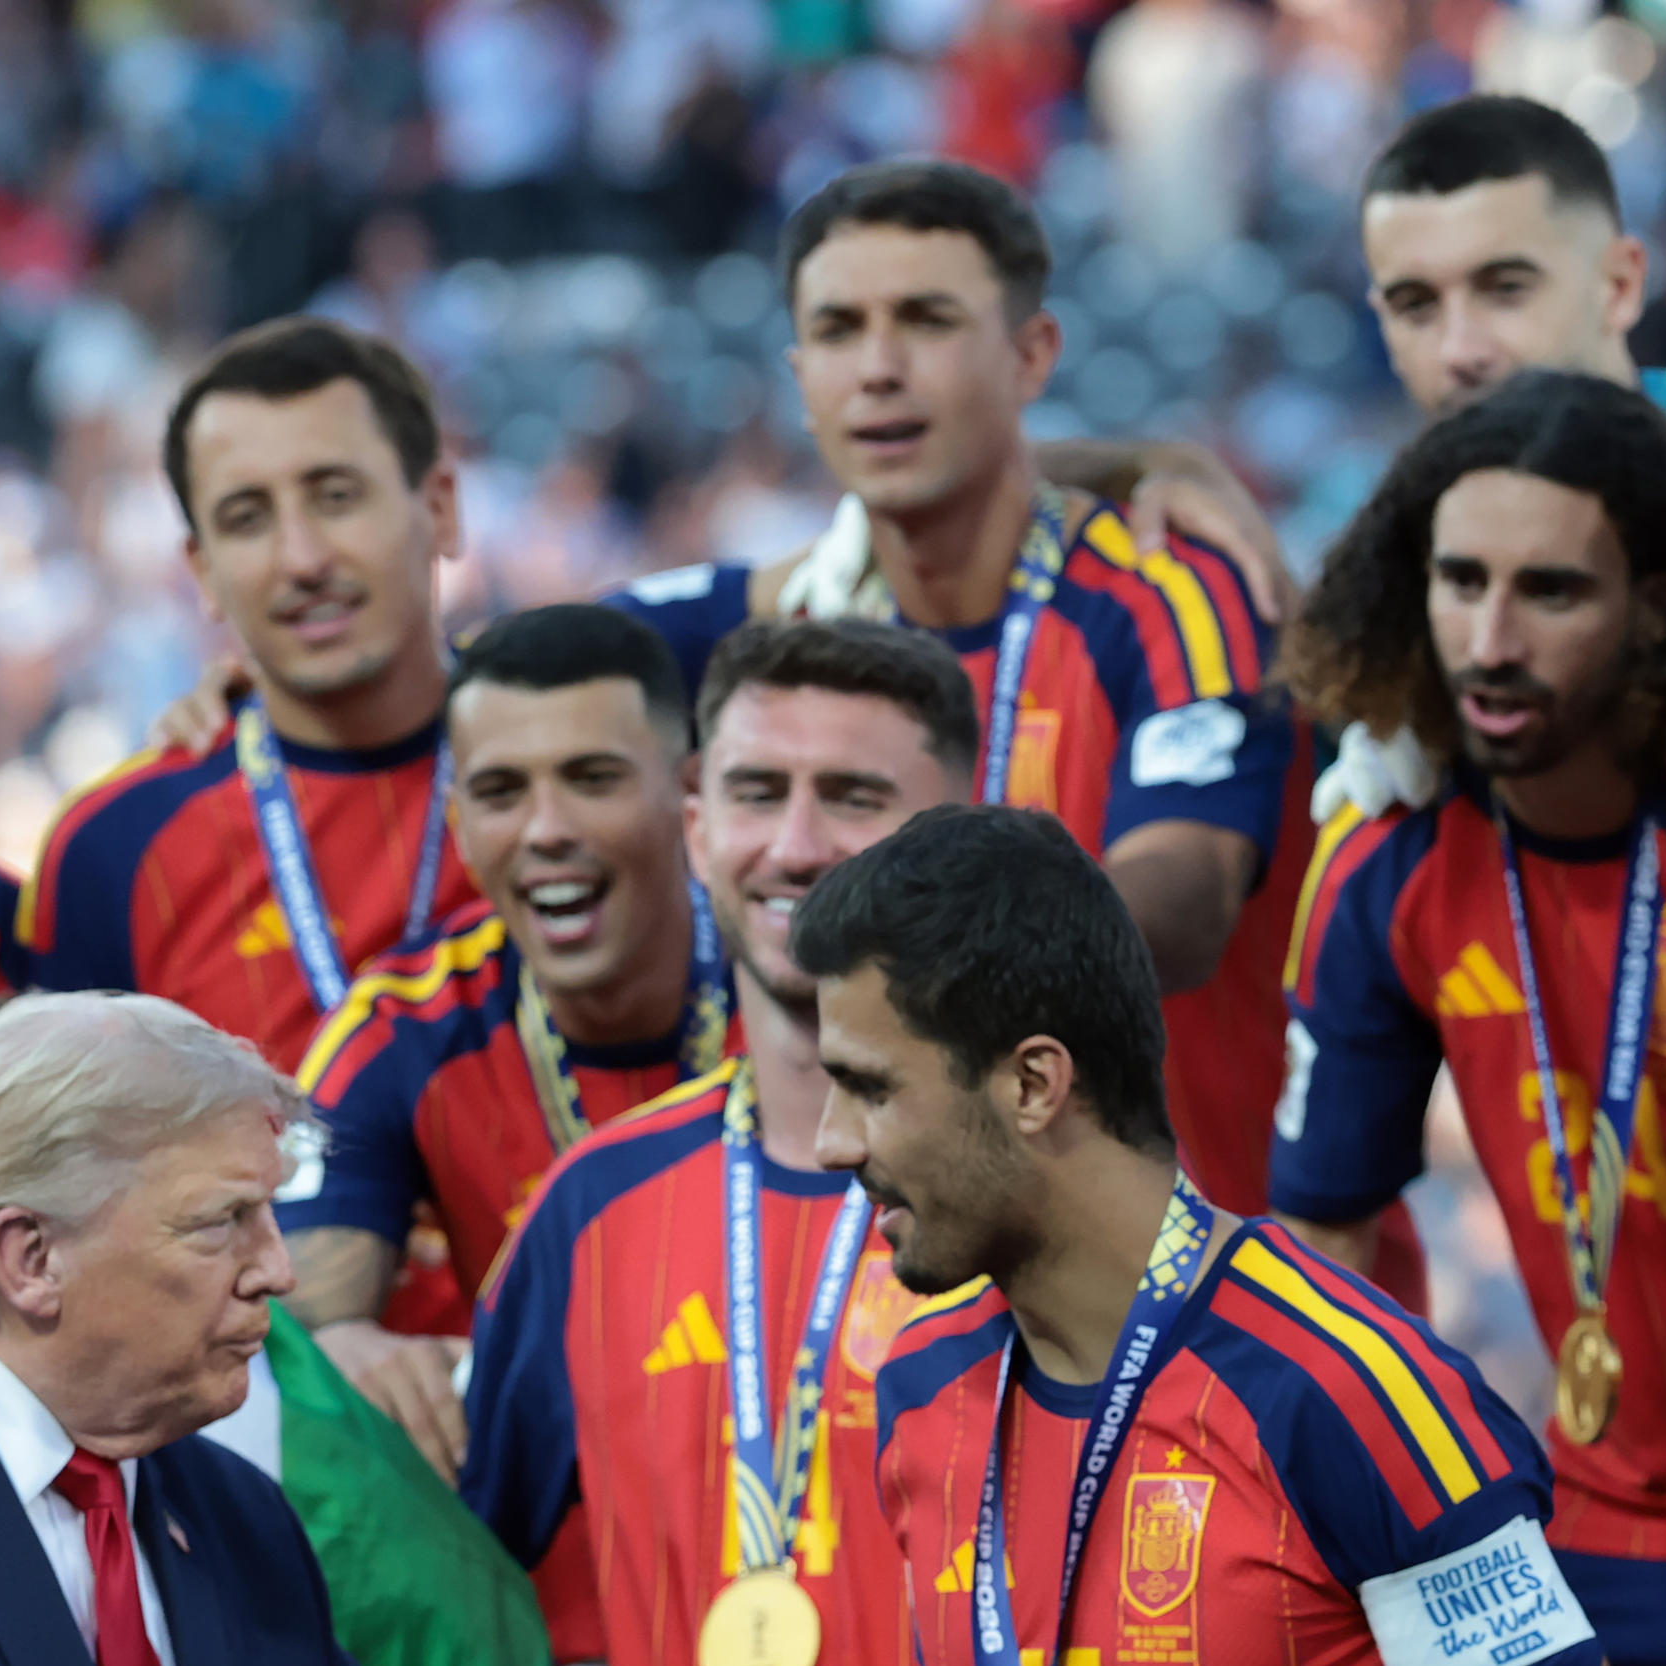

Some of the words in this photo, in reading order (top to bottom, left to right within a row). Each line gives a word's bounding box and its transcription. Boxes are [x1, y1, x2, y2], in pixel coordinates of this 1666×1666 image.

[1118, 1325, 1158, 1380] FIFA
[1087, 1382, 1136, 1474] WORLD
[1073, 1476, 1099, 1530] CUP
[1417, 1541, 1528, 1599] FOOTBALL
[1424, 1563, 1542, 1628] UNITES
[976, 1562, 1004, 1655] 2026
[1434, 1628, 1486, 1657] the
[1484, 1588, 1564, 1638] World
